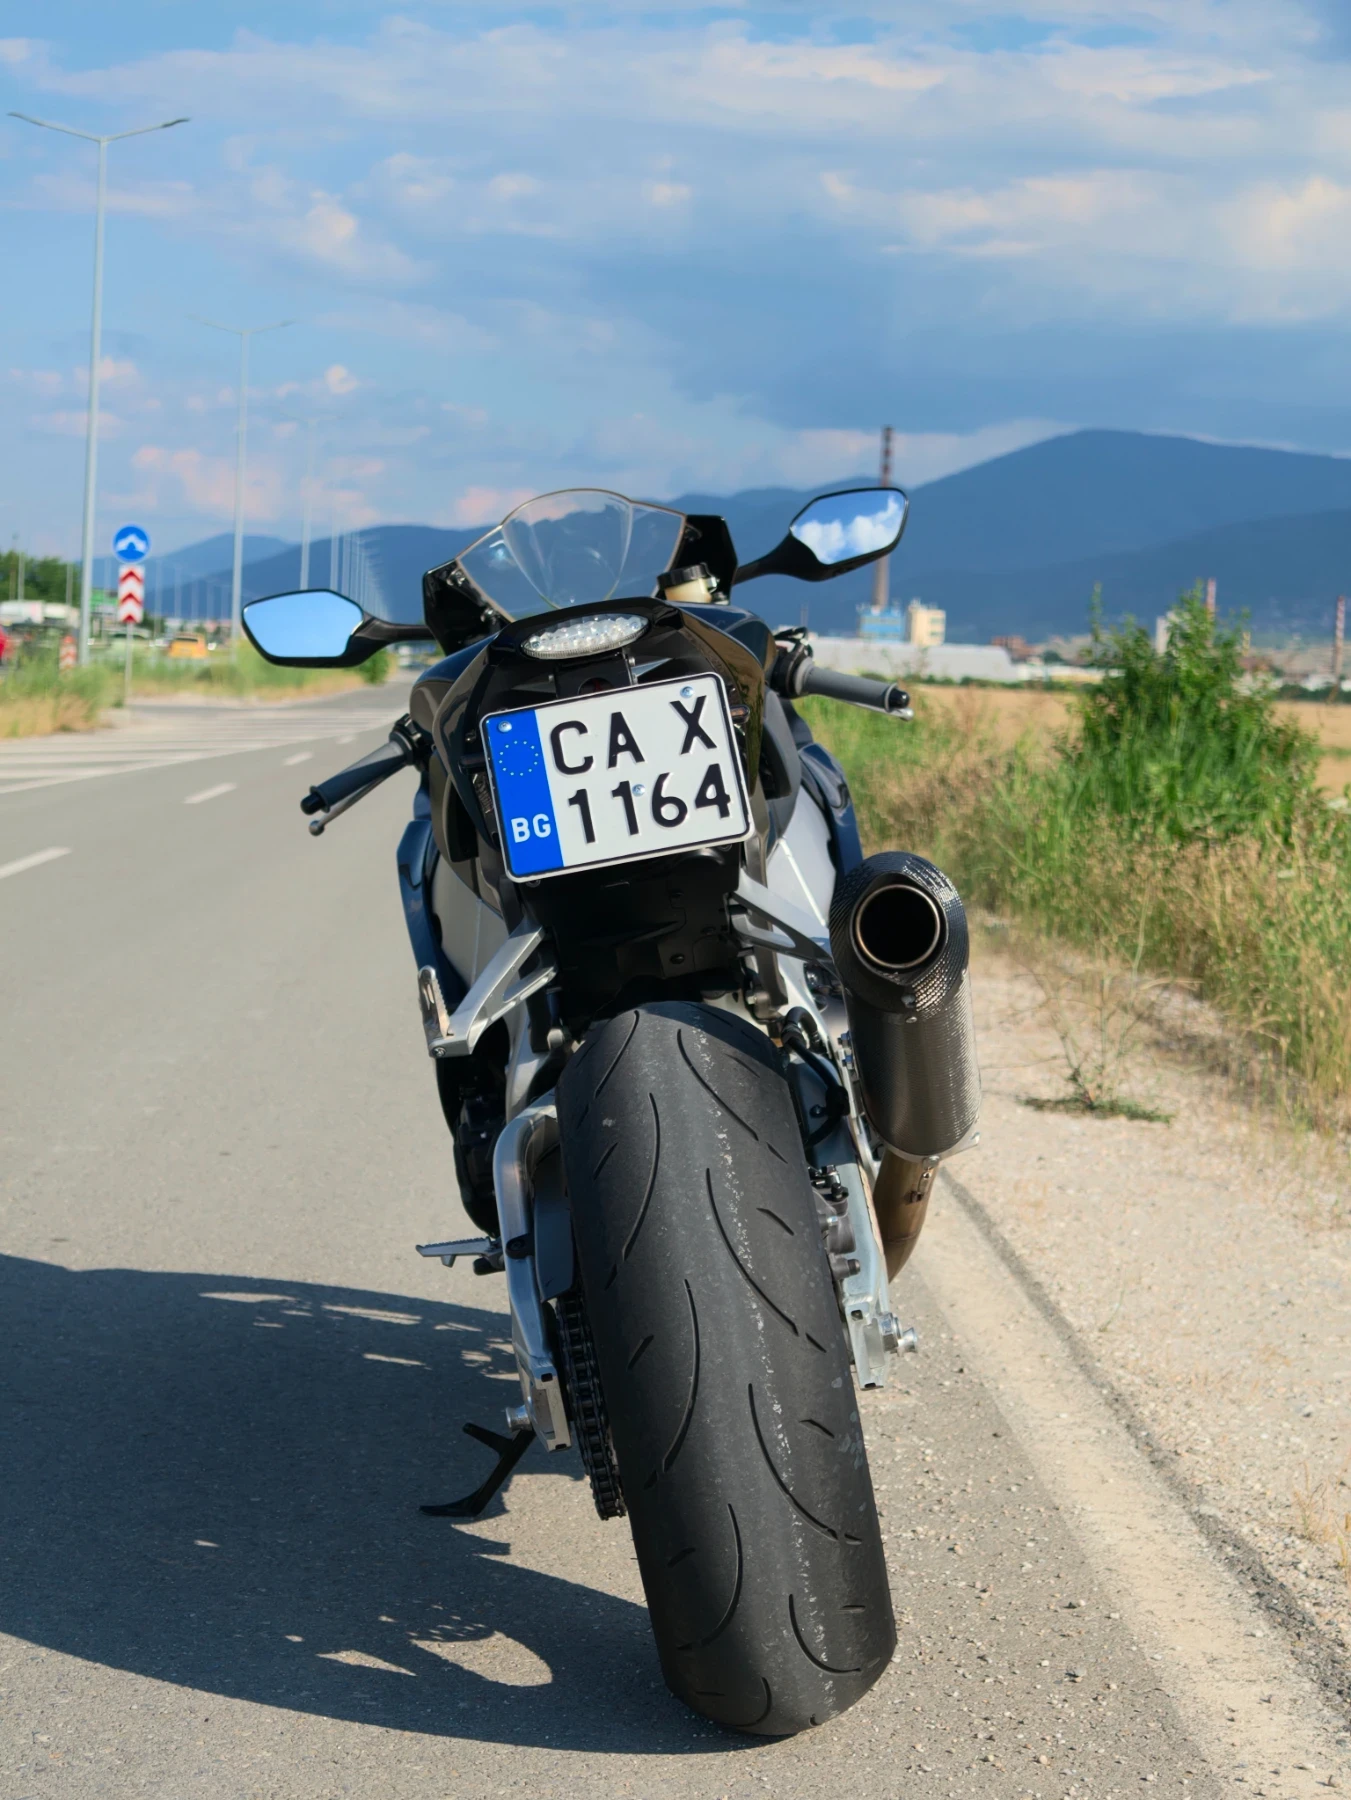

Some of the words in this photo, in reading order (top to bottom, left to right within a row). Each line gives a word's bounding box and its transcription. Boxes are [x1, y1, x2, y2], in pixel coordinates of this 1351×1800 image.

[550, 712, 645, 775] CA
[670, 695, 717, 755] X
[511, 813, 551, 843] BG
[568, 763, 731, 844] 1164
